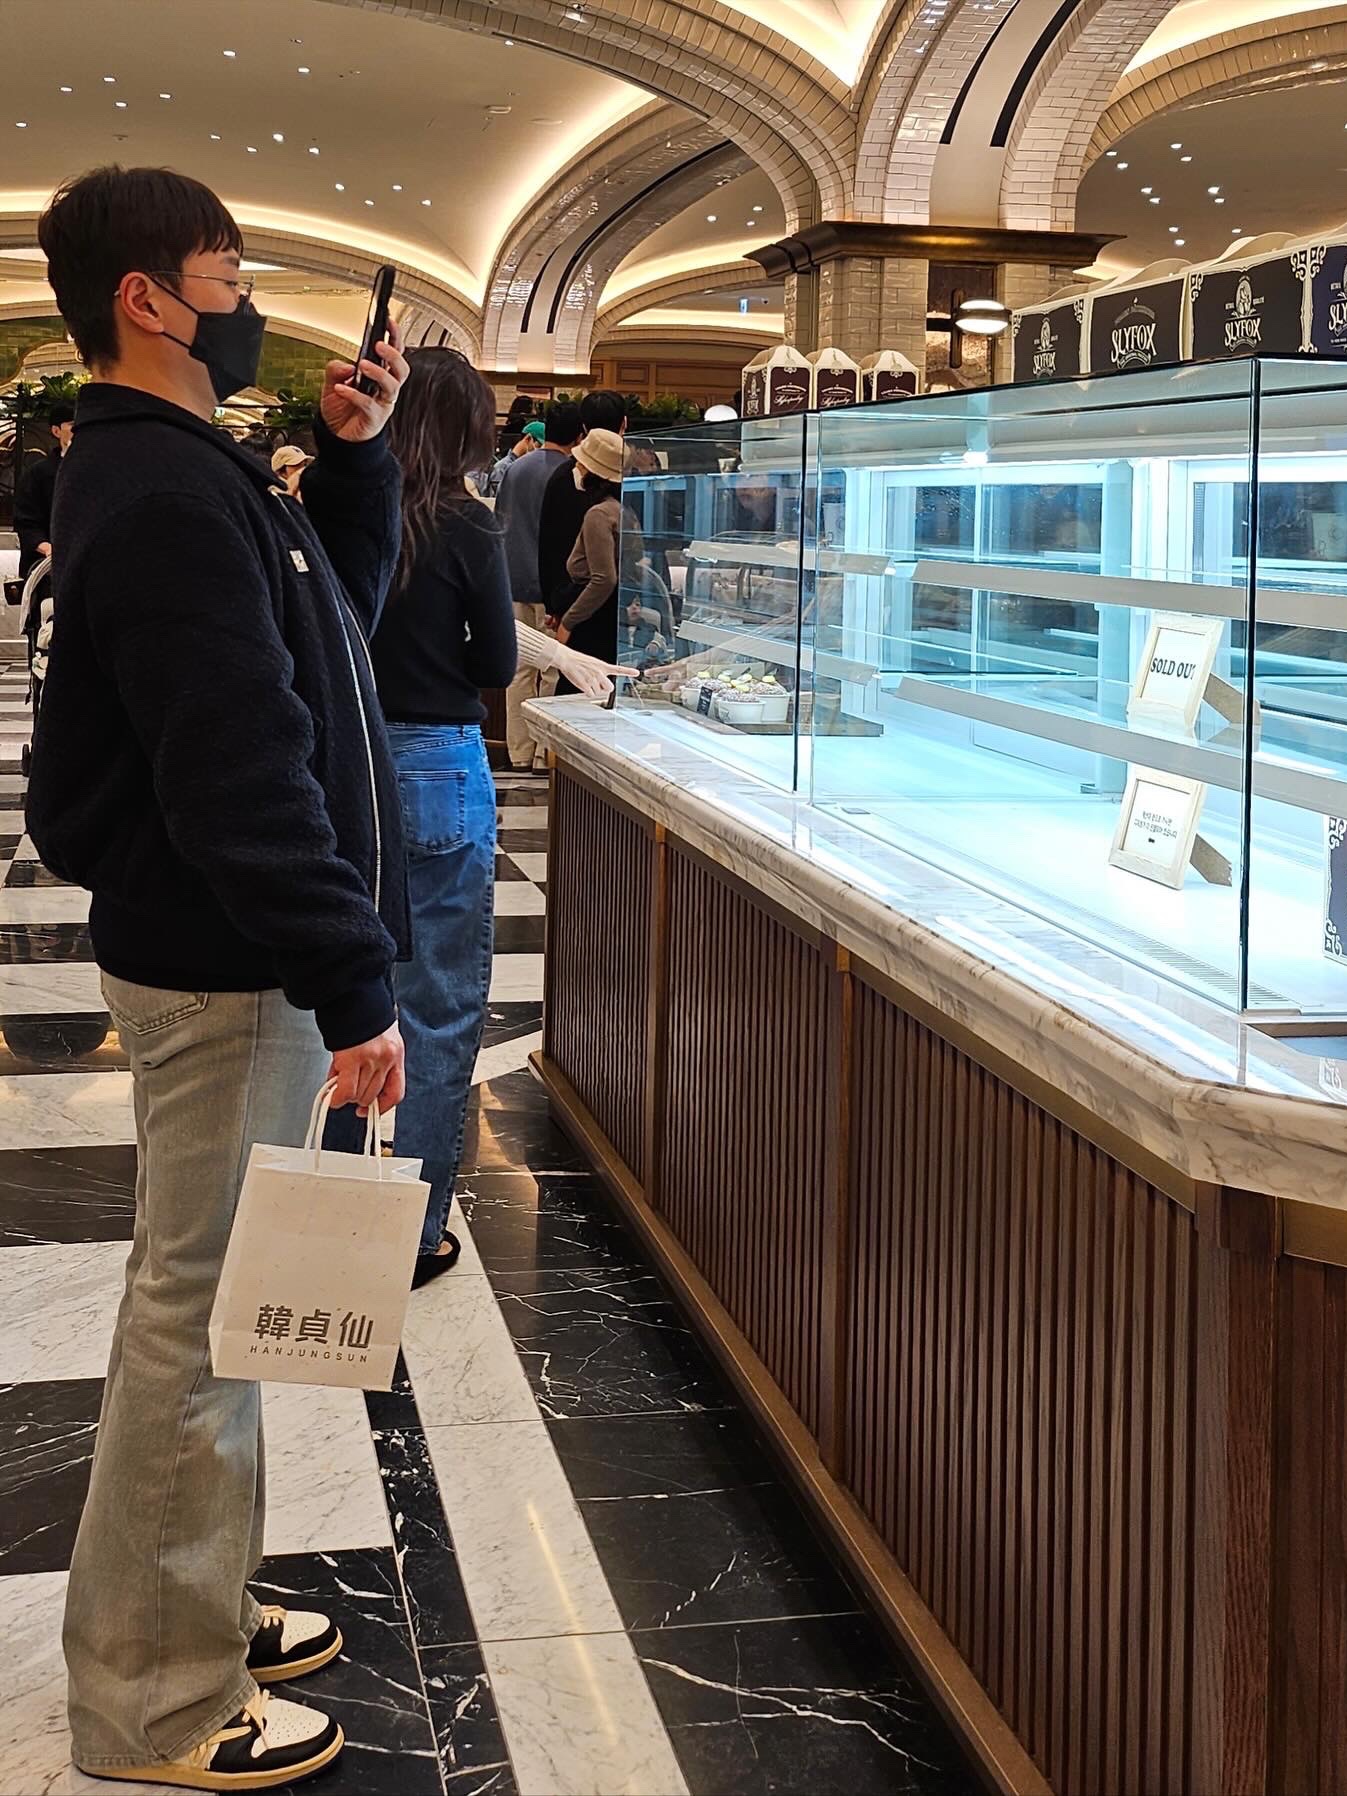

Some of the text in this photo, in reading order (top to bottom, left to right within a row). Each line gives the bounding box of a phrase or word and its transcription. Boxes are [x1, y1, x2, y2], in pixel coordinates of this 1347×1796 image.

[1111, 323, 1157, 363] SLYFOX
[1225, 317, 1261, 347] SLYFOX
[1033, 351, 1056, 375] SLYFOX
[1150, 657, 1176, 676] SOLD
[254, 1304, 374, 1349] 韓貞仙
[250, 1345, 368, 1363] HANJUNGSUN
